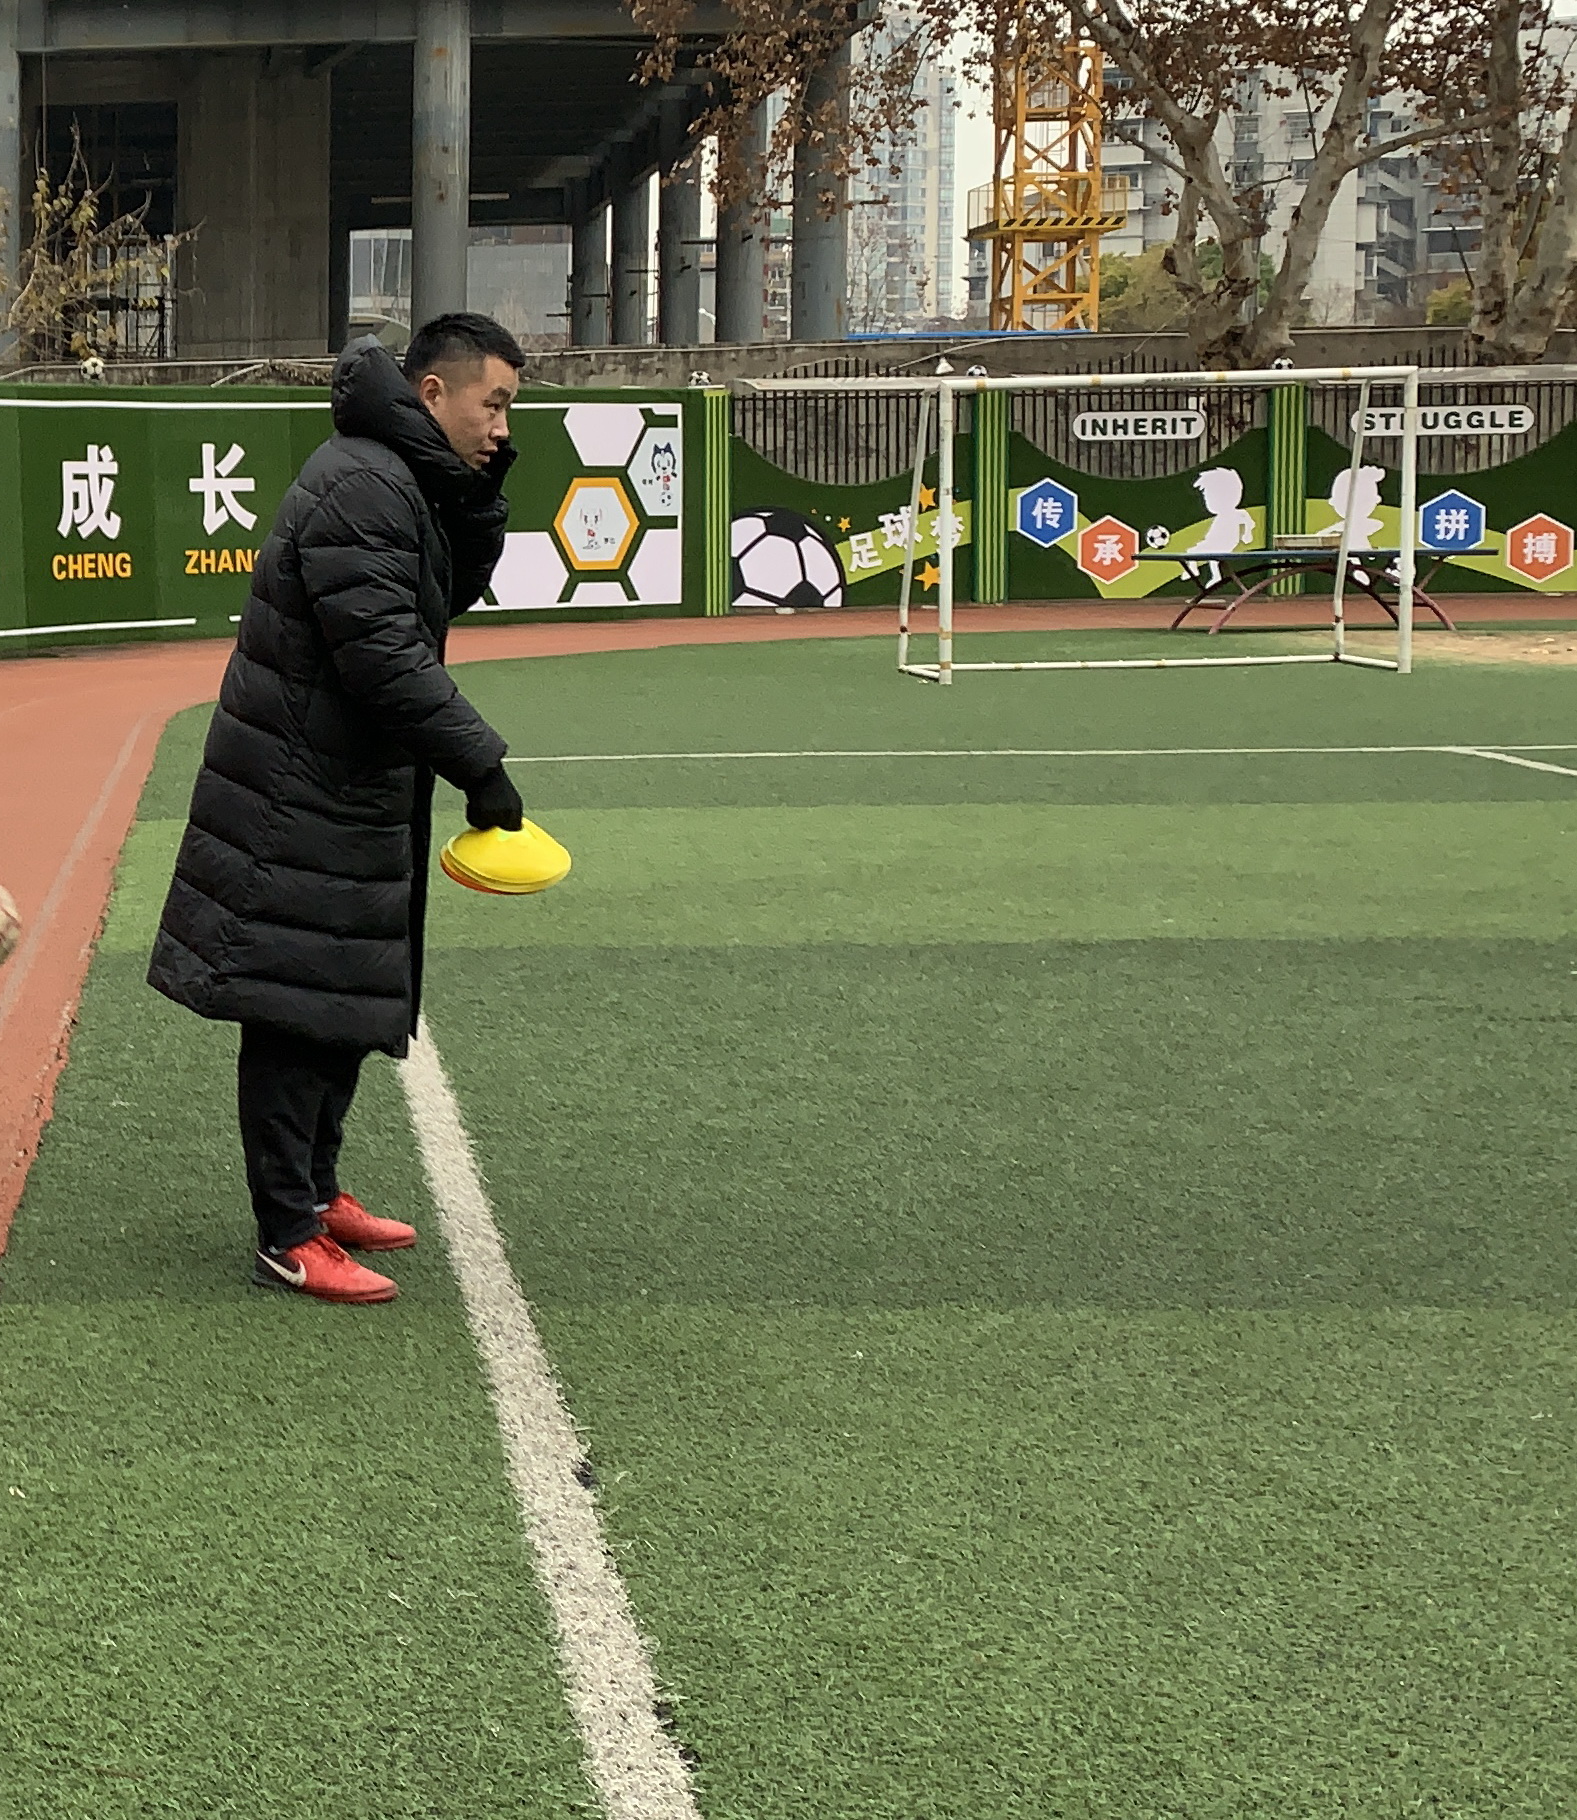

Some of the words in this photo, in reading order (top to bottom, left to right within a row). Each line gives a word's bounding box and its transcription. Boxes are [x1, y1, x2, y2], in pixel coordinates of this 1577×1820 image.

[1080, 417, 1198, 436] INHERIT
[1364, 410, 1525, 431] STUGGLE
[52, 552, 132, 581] CHENG
[184, 548, 262, 575] ZHAN
